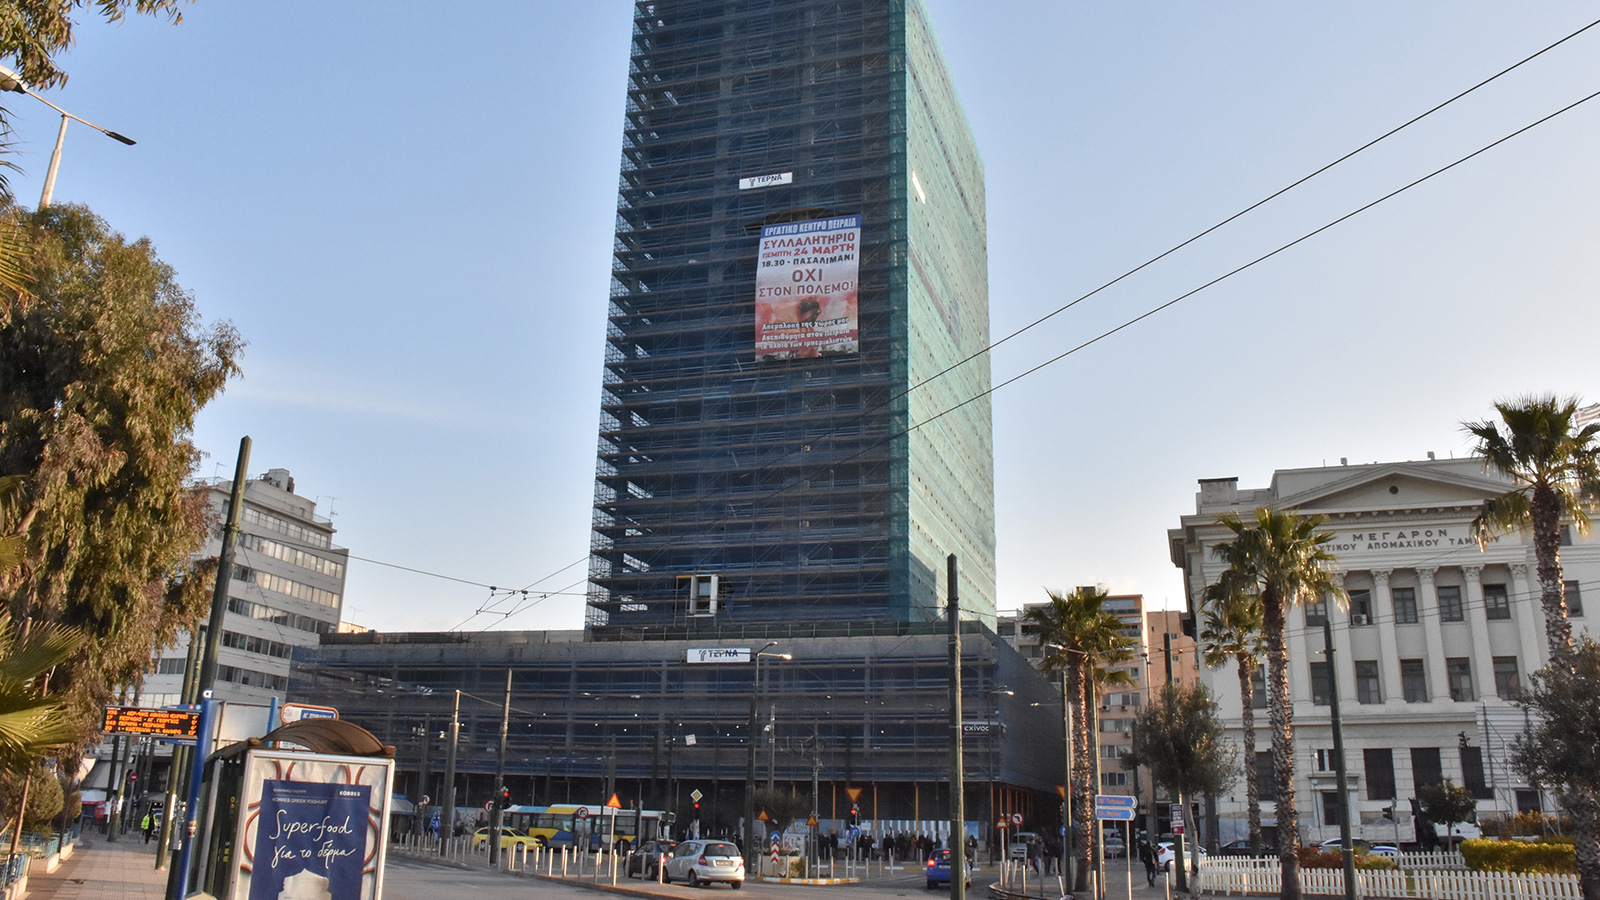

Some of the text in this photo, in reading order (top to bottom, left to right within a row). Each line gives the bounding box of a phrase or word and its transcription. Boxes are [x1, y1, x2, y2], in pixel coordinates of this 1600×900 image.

[764, 217, 857, 237] ΕΡΓΑΤΙΚΟ ΚΕΝΤΡΟ ΠΕΙΡΑΙΑ
[763, 232, 856, 250] ΣΥΛΛΑΛΗΤΗΡΙΟ
[762, 243, 855, 259] ΠΕΜΠΤΗ 24 ΜΑΡΤΗ
[762, 259, 785, 268] 18.30
[792, 253, 854, 265] ΠΑΣΑΛΙΜΑΝΙ
[791, 268, 823, 283] ΟΧΙ
[758, 281, 854, 297] ΣΤΟΝ ΠΟΛΕΜΟ!
[836, 317, 849, 325] μας
[1352, 528, 1448, 542] ΜΕΓΑΡΟΝ
[1367, 539, 1439, 550] ΑΠΟΜΑΧΙΚΟΥ
[1449, 535, 1500, 546] ΤΑΜΥ
[708, 649, 739, 658] ΤΕΡΝΑ
[271, 840, 357, 870] για το δέρμα
